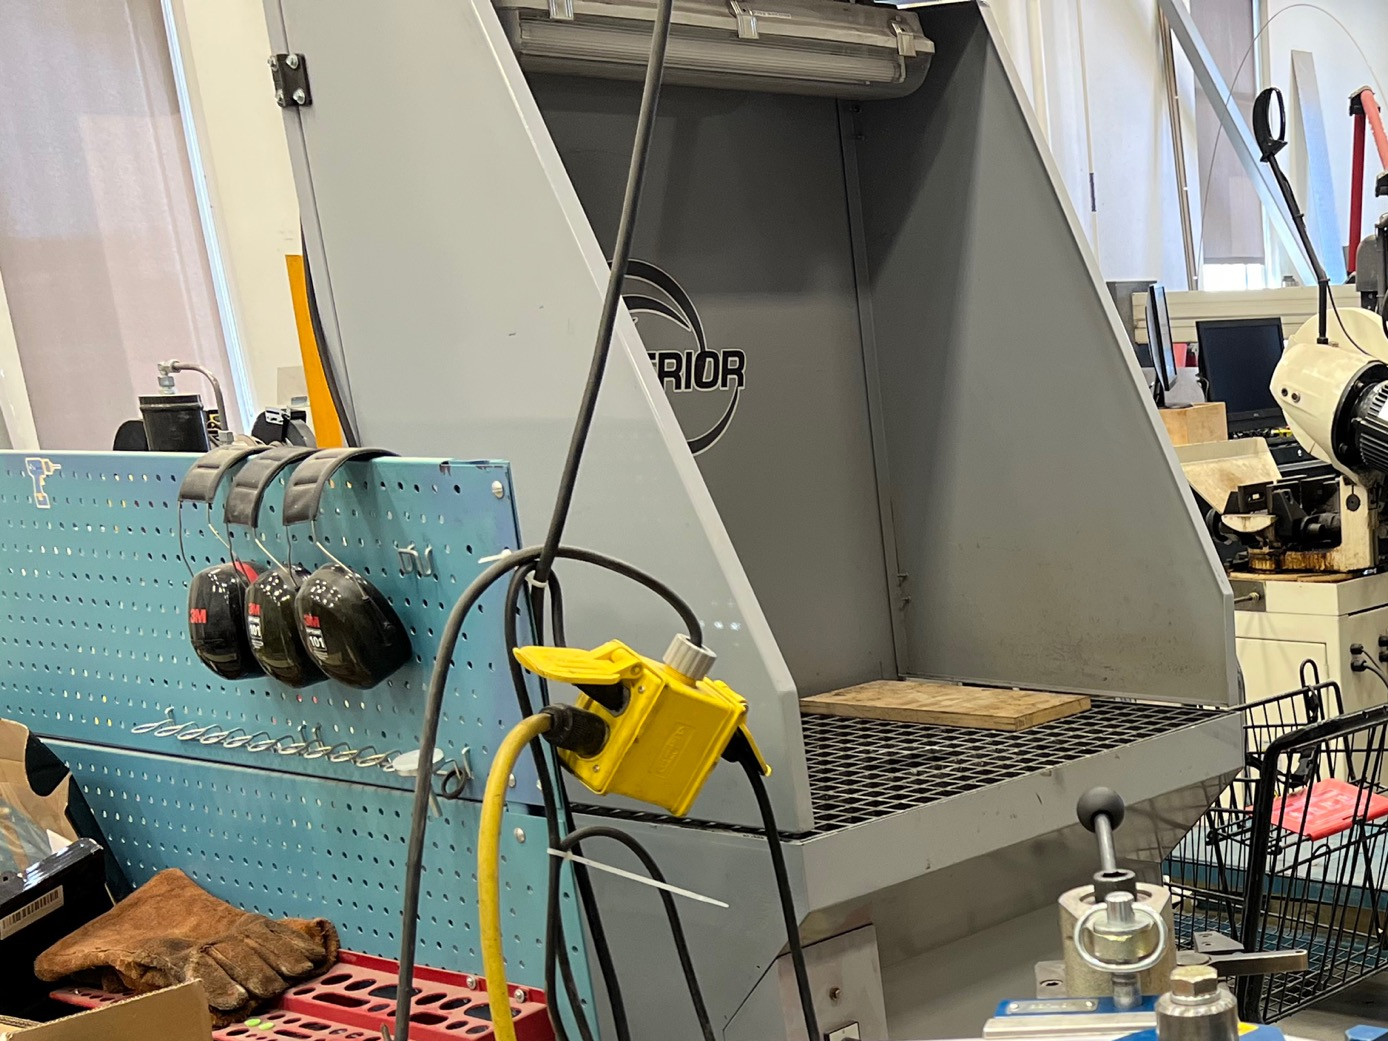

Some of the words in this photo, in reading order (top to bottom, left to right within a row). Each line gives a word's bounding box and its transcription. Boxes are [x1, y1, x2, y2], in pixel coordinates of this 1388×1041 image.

[190, 608, 207, 624] 3M
[248, 602, 261, 616] 3M
[309, 635, 326, 649] 101
